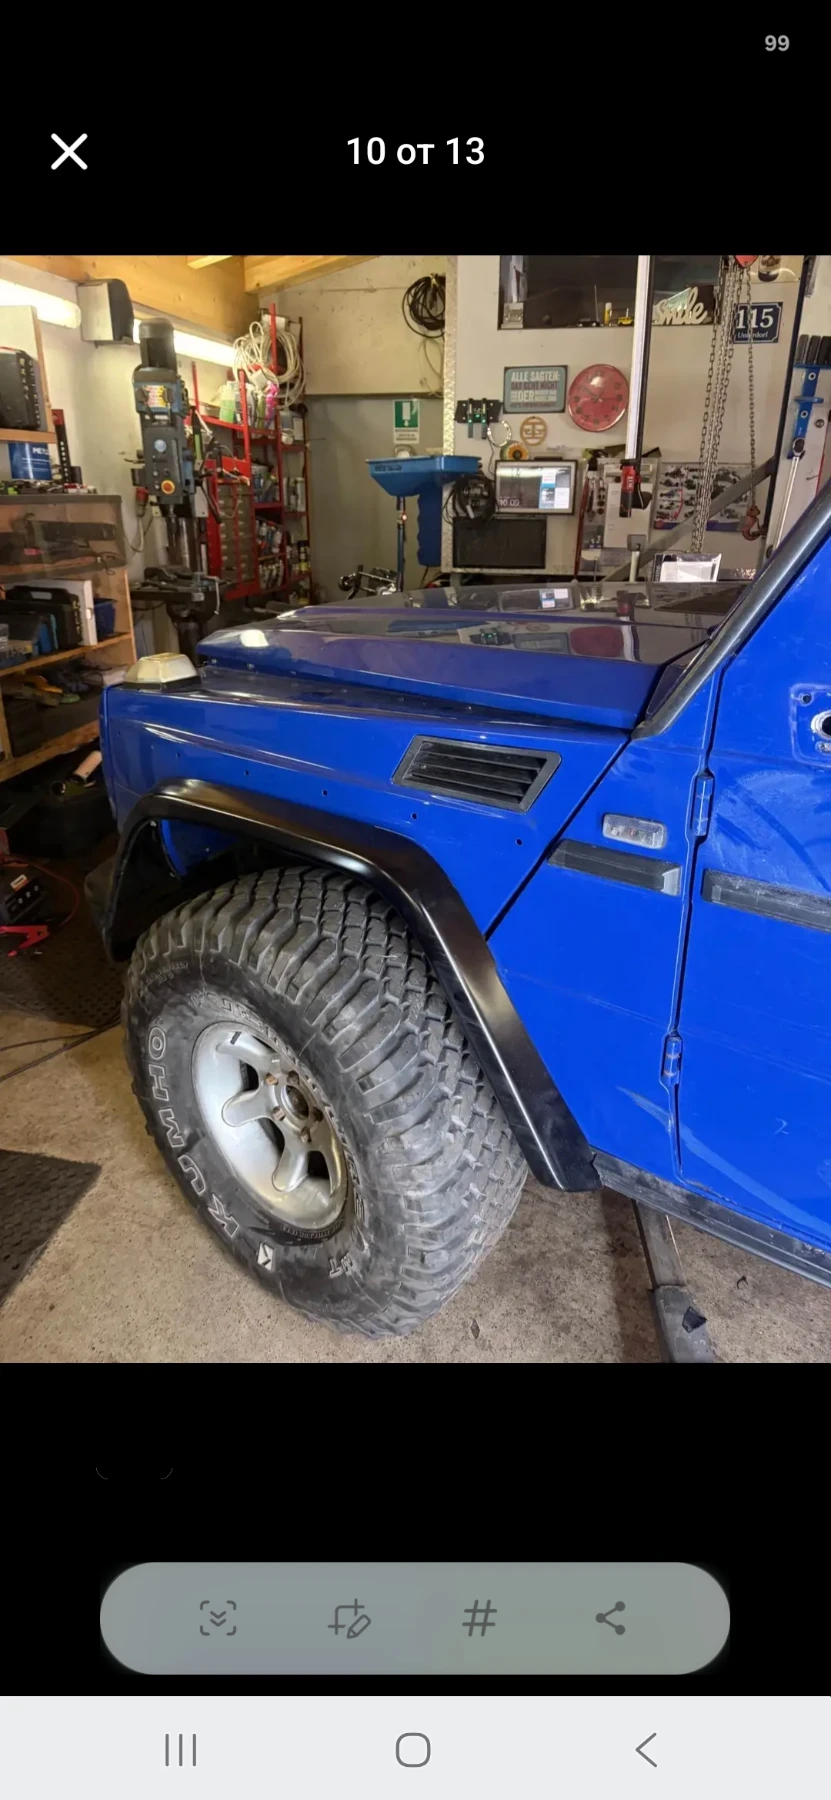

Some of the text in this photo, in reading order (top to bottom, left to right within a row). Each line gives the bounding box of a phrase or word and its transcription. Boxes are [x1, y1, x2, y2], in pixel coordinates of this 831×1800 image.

[653, 286, 708, 325] Smile
[736, 307, 774, 329] 115
[511, 371, 529, 382] ALLE
[517, 390, 535, 402] DER
[148, 1026, 240, 1239] KUMHO
